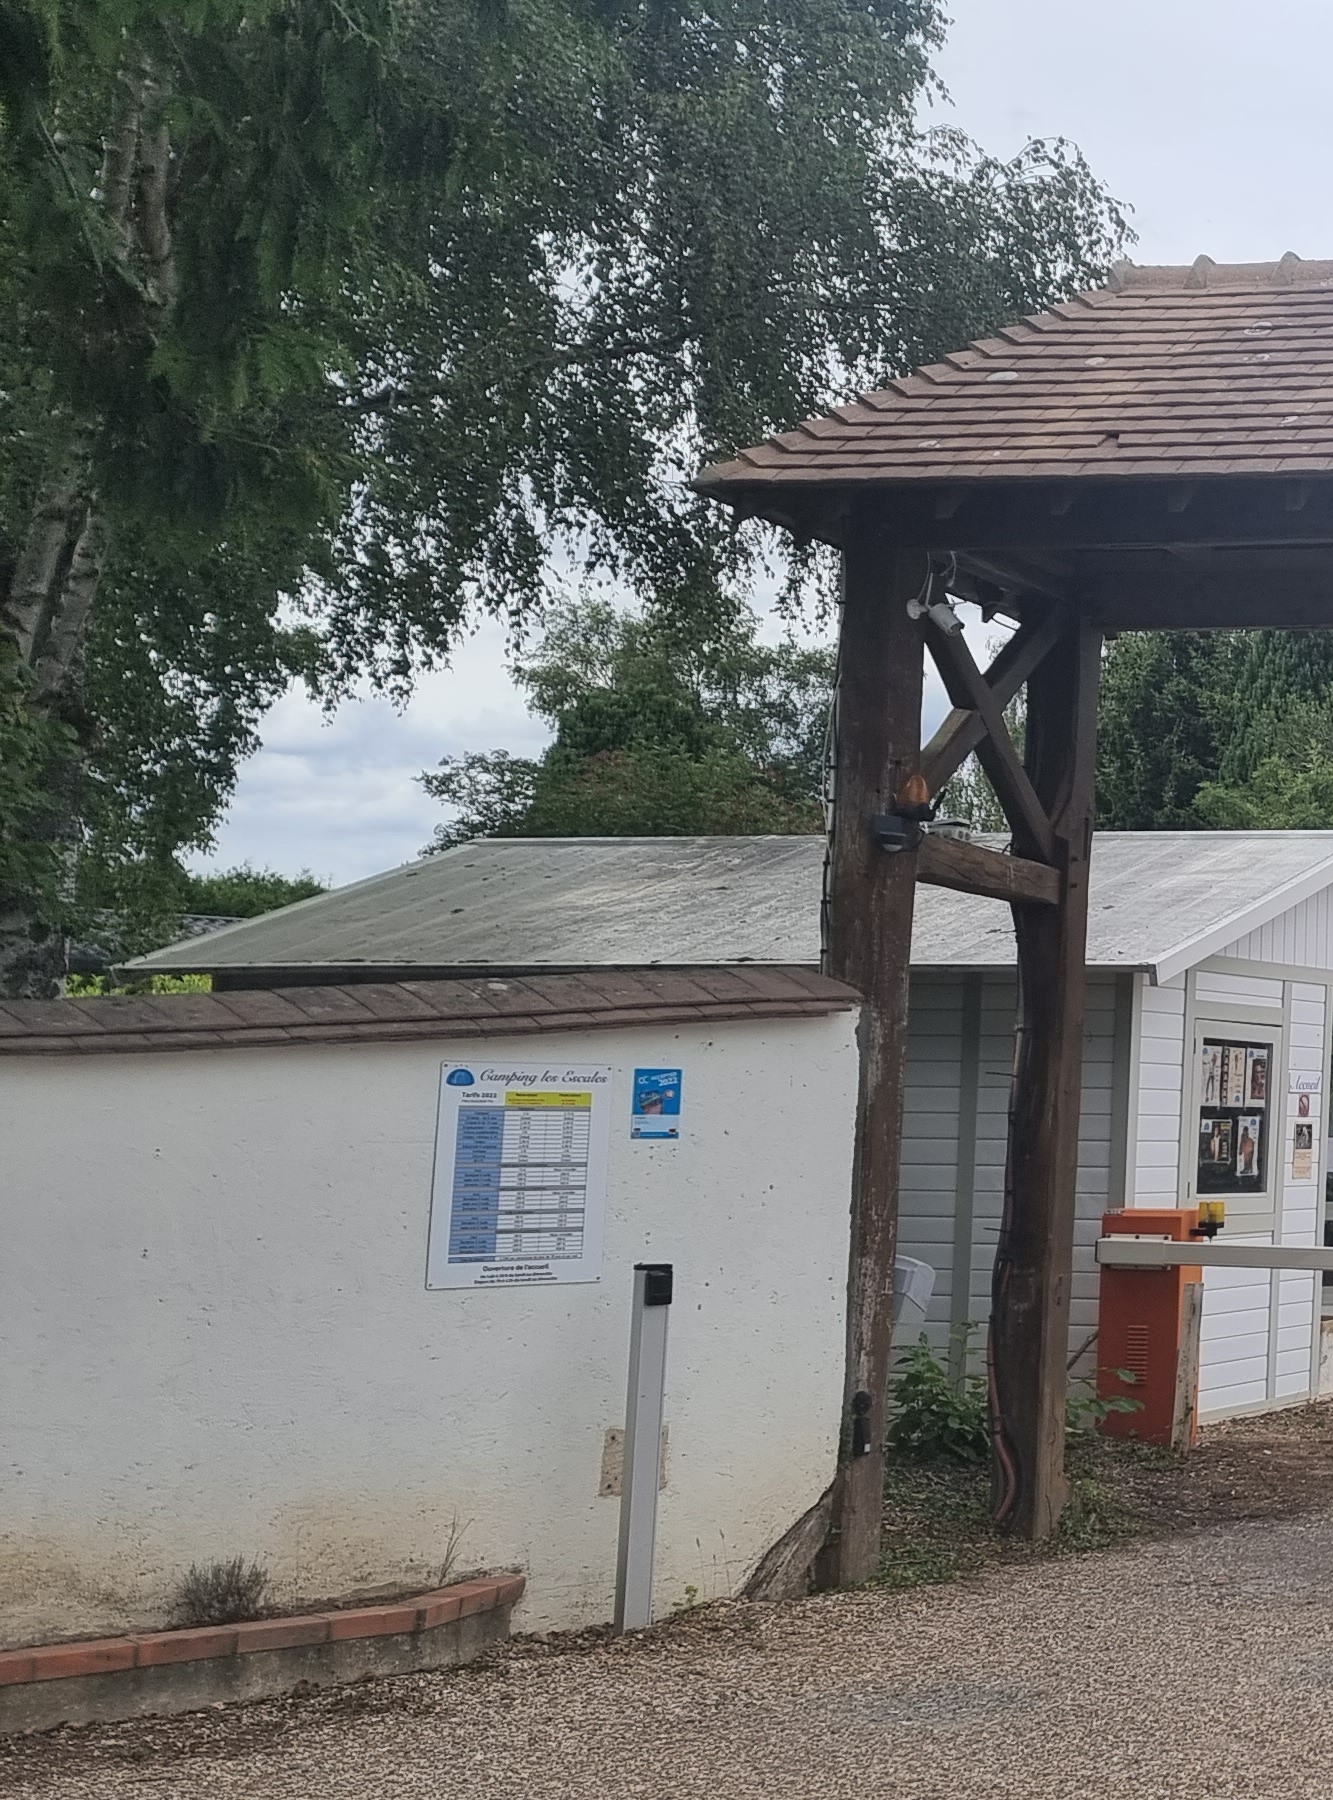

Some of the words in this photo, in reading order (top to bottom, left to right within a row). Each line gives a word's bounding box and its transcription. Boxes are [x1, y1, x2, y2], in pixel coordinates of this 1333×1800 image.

[480, 1068, 538, 1086] Camping
[540, 1069, 558, 1083] les
[562, 1070, 608, 1083] Escales
[482, 1264, 515, 1272] Ouverture
